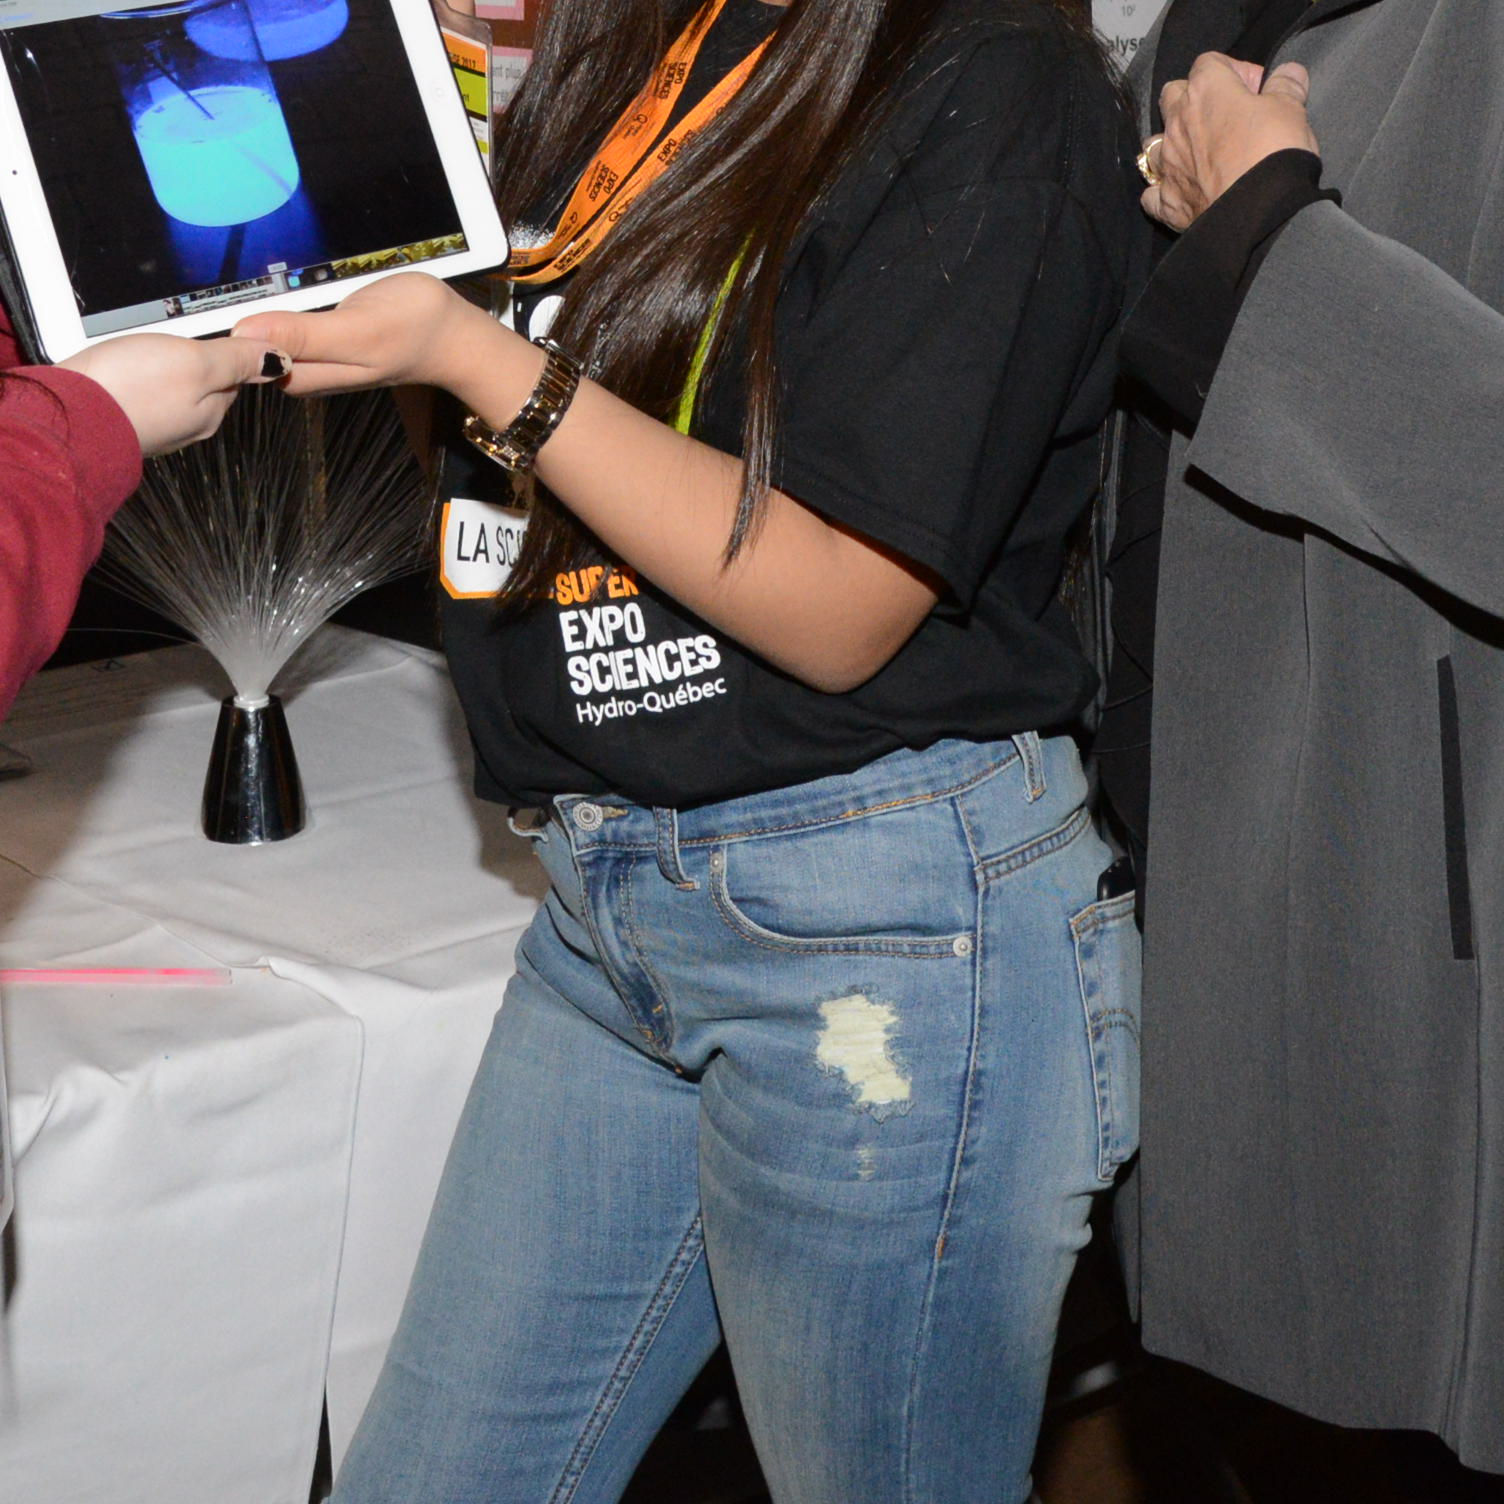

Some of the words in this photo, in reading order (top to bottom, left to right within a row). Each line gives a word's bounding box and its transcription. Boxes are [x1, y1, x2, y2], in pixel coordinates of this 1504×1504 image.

[457, 521, 490, 563] LA
[559, 602, 646, 653] EXPO
[567, 634, 721, 696] SCIENCES
[576, 677, 727, 726] Hydro-Québec
